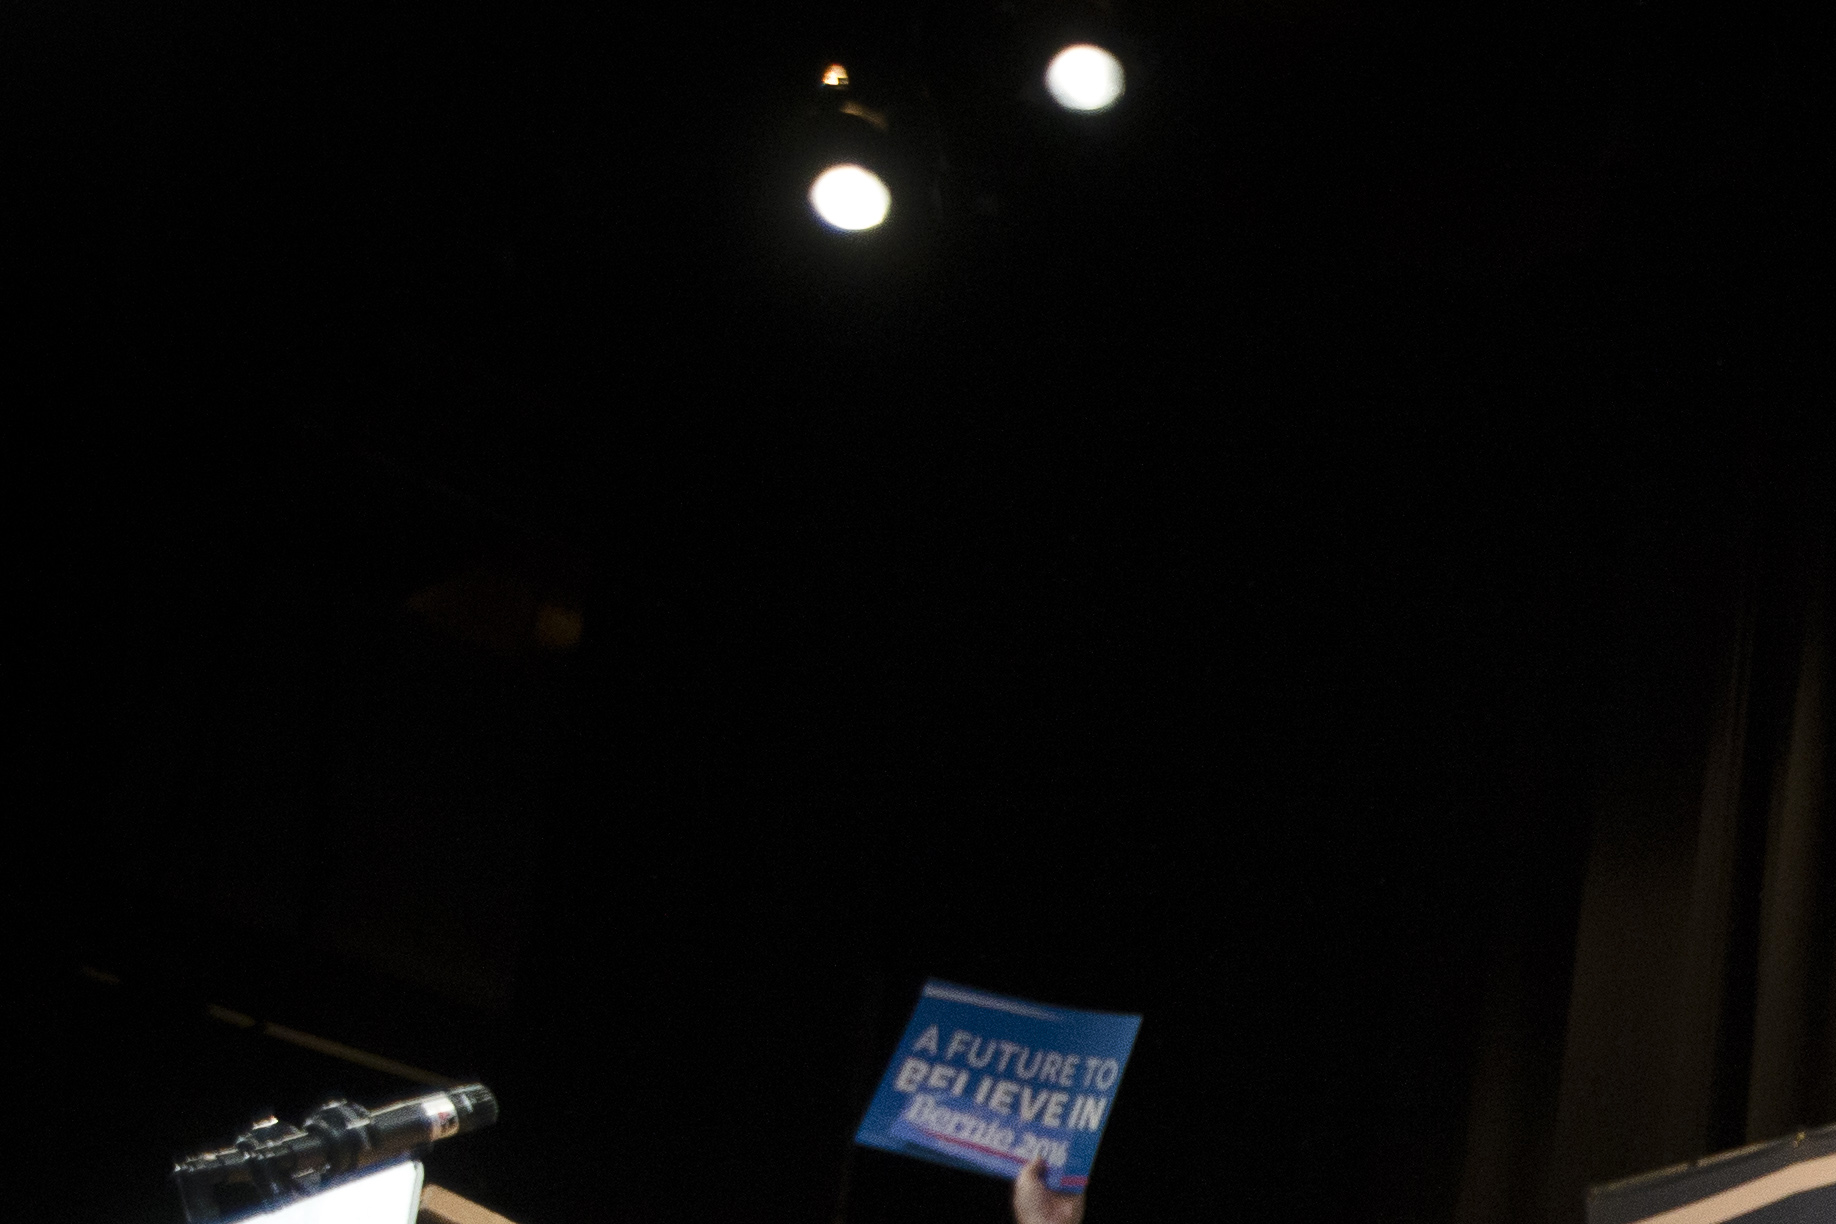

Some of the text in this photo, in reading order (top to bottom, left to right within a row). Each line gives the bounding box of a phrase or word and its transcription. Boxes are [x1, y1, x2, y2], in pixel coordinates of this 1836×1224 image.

[893, 1055, 1109, 1133] BELIEVE IN
[911, 1021, 1120, 1093] A FUTURE TO
